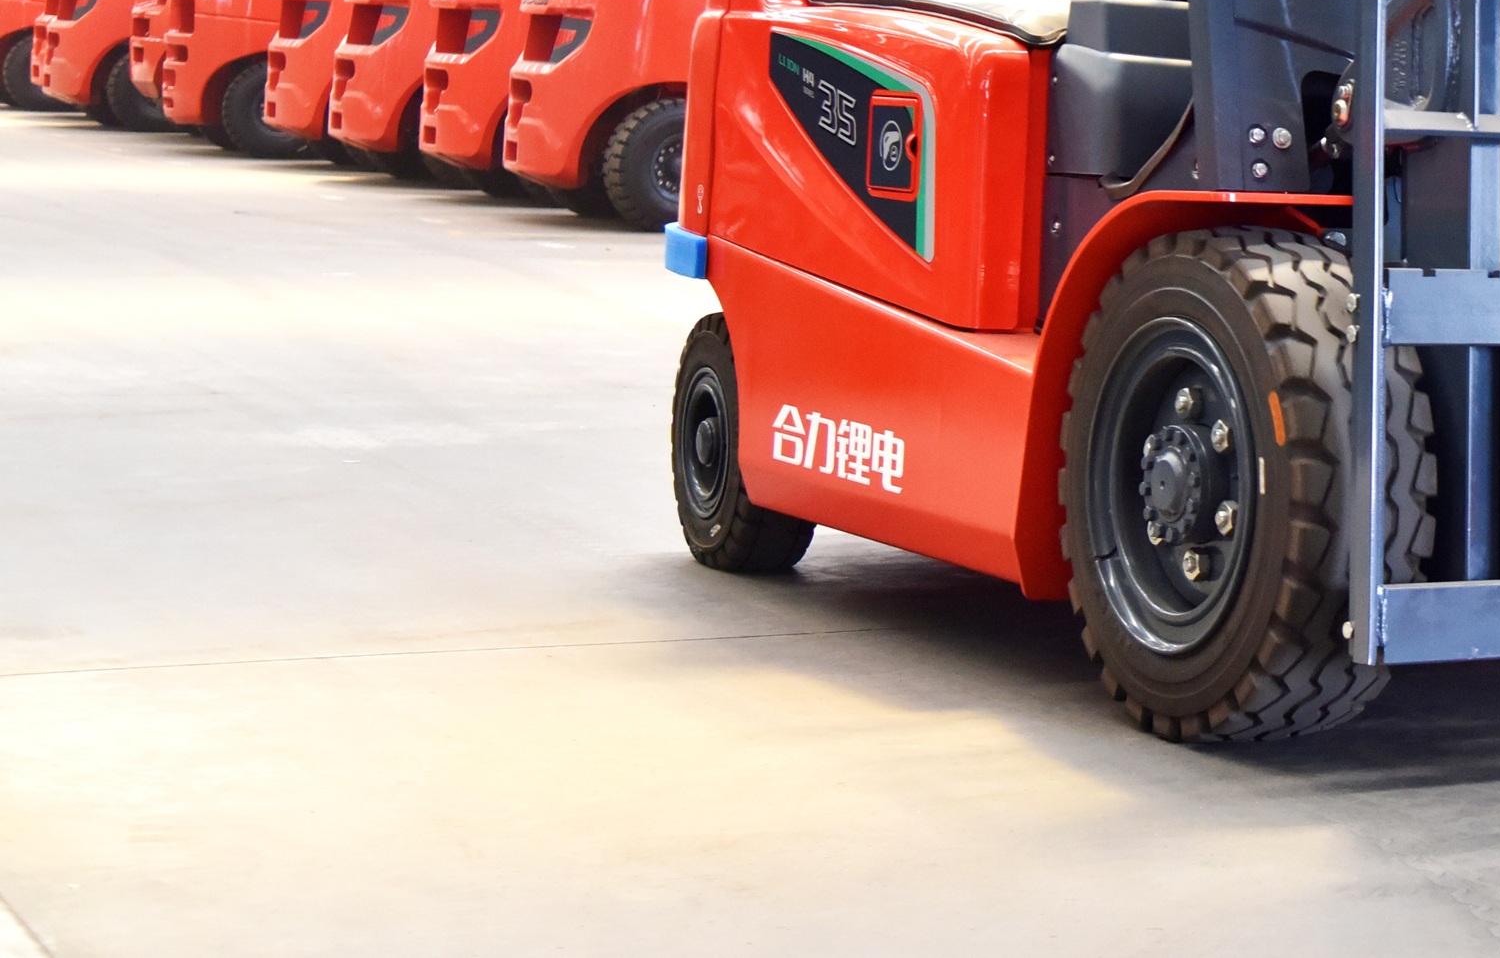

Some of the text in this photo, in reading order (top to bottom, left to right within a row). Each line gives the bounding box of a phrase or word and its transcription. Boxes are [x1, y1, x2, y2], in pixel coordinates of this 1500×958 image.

[817, 79, 857, 146] 35
[771, 403, 905, 495] 合力锂电
